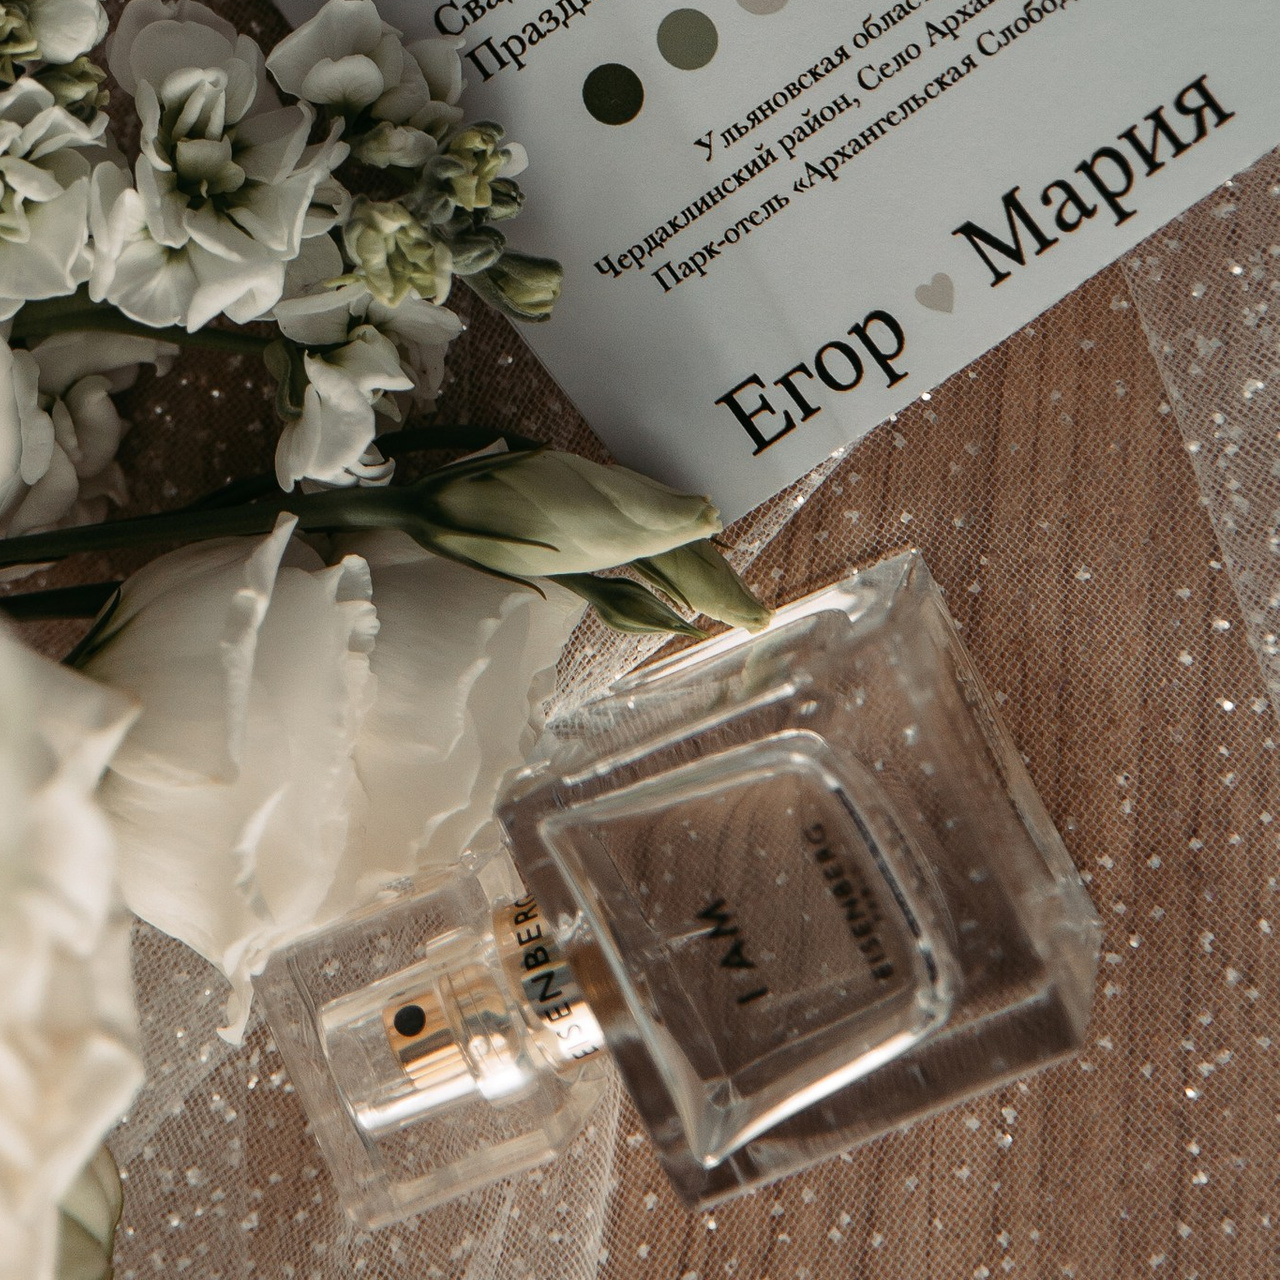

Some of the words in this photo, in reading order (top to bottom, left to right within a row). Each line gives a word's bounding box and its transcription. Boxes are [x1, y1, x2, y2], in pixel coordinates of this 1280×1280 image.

[592, 142, 779, 279] Чердаклинский
[776, 93, 861, 161] район,
[856, 42, 922, 91] Село
[650, 193, 791, 294] Парк-отель
[792, 53, 979, 194] «Архангельская
[713, 309, 910, 457] Егор
[950, 73, 1236, 288] Мария
[697, 897, 757, 970] AM
